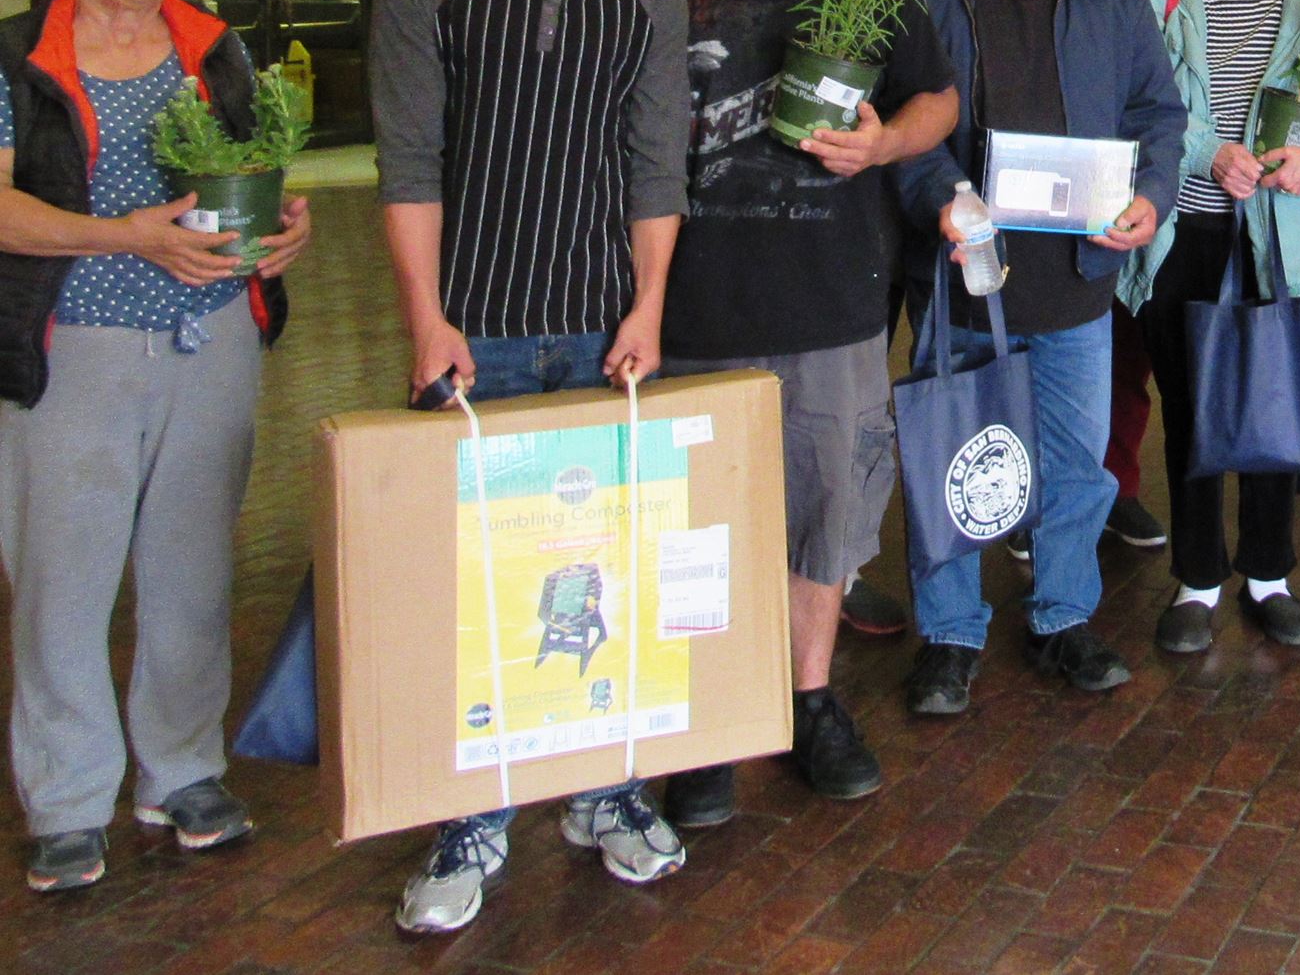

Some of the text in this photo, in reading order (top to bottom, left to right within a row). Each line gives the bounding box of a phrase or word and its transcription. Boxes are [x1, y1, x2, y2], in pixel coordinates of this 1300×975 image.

[964, 435, 988, 461] SAN
[952, 459, 967, 480] OF
[950, 483, 965, 514] CITY
[476, 511, 565, 531] umbling
[965, 518, 998, 535] WATER
